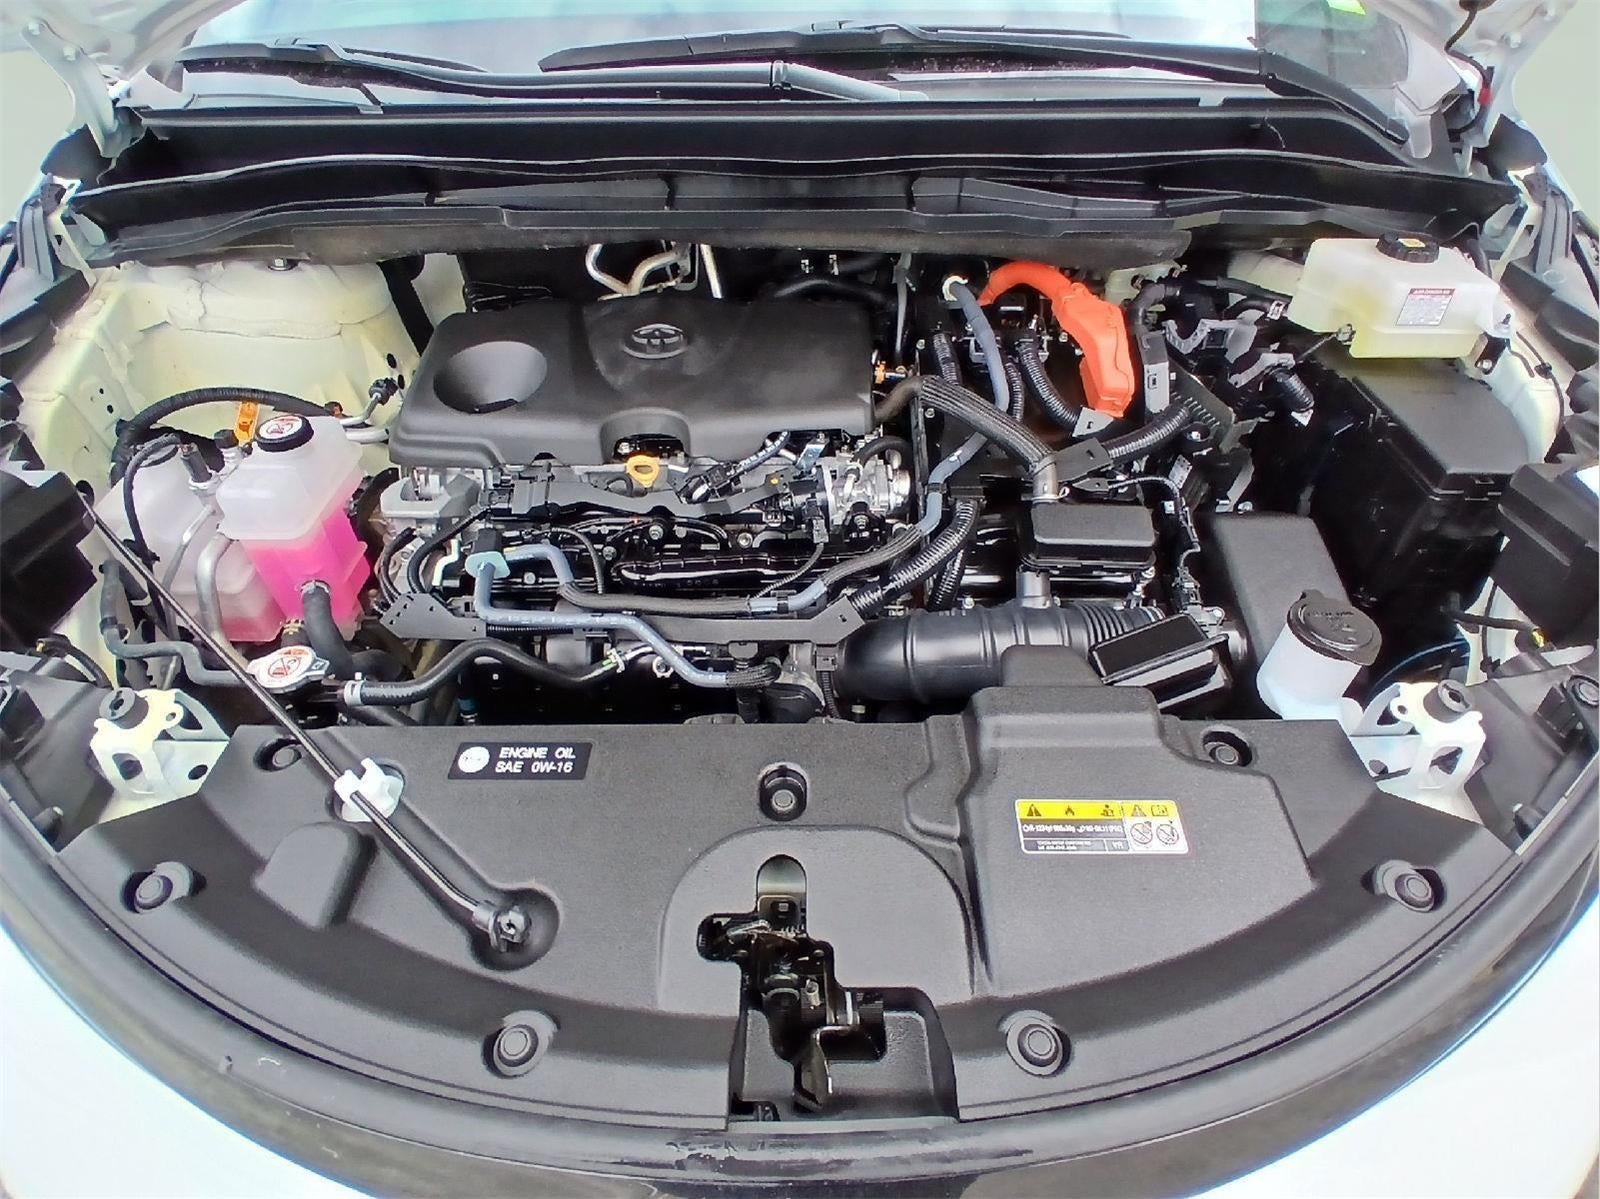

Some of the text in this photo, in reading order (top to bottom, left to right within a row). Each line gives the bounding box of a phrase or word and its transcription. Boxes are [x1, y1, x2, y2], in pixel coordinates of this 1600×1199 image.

[498, 747, 576, 759] ENGINE OIL
[495, 761, 573, 773] SAE 0W-16
